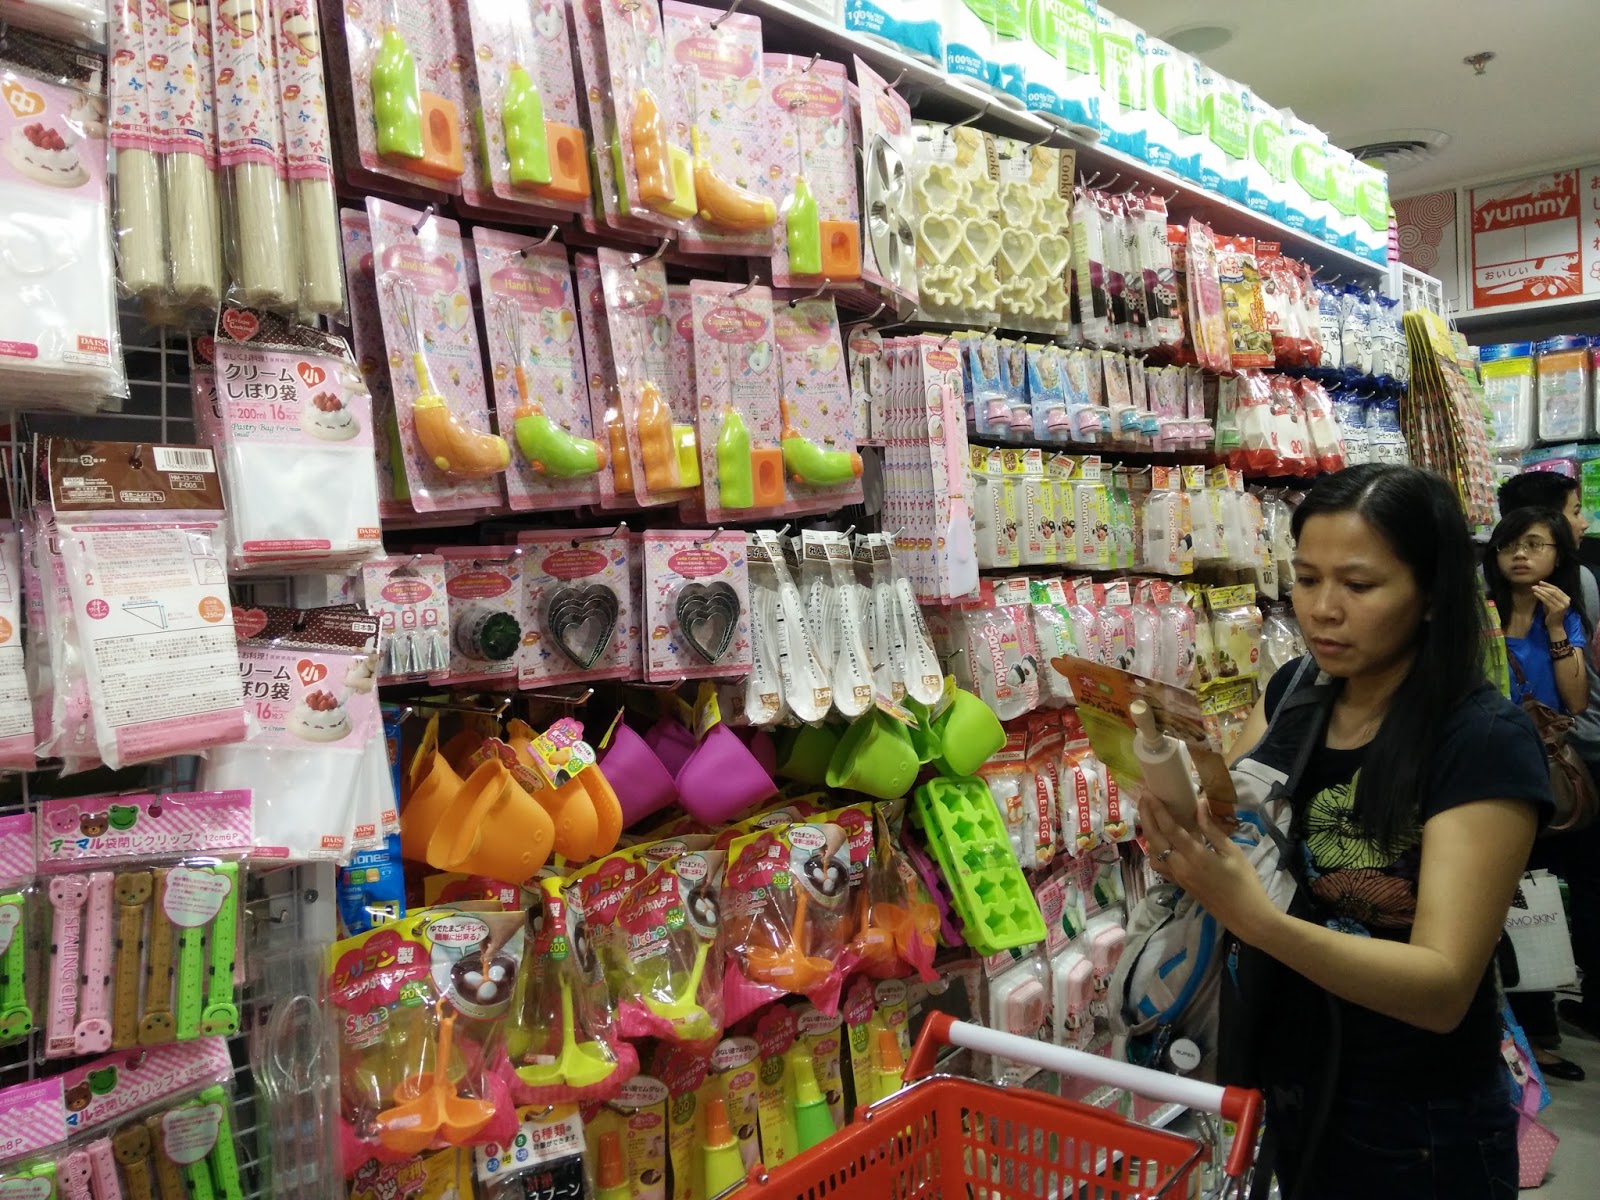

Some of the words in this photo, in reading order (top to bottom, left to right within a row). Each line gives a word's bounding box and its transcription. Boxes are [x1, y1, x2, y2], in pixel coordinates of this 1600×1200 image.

[1046, 0, 1095, 31] KITCHEN
[1053, 17, 1091, 48] TOWEL
[1482, 196, 1571, 229] yummy
[418, 263, 443, 276] Mixer
[1485, 267, 1529, 280] おいしい
[504, 279, 527, 291] Hand
[528, 281, 551, 295] Mixer
[744, 318, 762, 327] Mixer
[81, 337, 110, 349] DAISO
[225, 363, 296, 383] クリーム
[302, 369, 320, 384] 小
[226, 383, 298, 402] しぼり袋
[237, 408, 267, 420] 200ml
[231, 423, 257, 434] Pastry
[259, 424, 274, 434] Bag
[1584, 482, 1598, 492] Ice
[992, 487, 1002, 545] Manmaru
[1026, 485, 1036, 543] Manmaru
[1081, 492, 1090, 545] Manmaru
[1168, 501, 1177, 553] Korokoro
[84, 573, 95, 586] 2
[353, 623, 375, 631] 日本製
[1100, 620, 1113, 666] Sankak
[983, 624, 1006, 688] Sankaku
[239, 662, 292, 681] リーム
[301, 666, 319, 681] 小
[242, 681, 291, 701] ぼり袋
[1109, 795, 1119, 816] EGG
[1040, 815, 1050, 838] EGG
[1080, 806, 1089, 828] EGG
[49, 832, 194, 853] アニマル袋閉じクリップ
[203, 833, 239, 842] 12cm6P
[584, 886, 631, 916] エッグホルダ
[626, 877, 673, 910] シリコン製
[626, 897, 676, 923] エッグホルダー
[1505, 914, 1533, 927] SMO
[1534, 912, 1556, 924] SKIN
[429, 924, 488, 933] ゆでたまごがキレイに
[62, 917, 80, 983] SEALING
[336, 946, 415, 988] シリコン製
[61, 984, 78, 1017] CLIP
[66, 1073, 174, 1126] マル袋閉じクリップ
[532, 1123, 572, 1143] 6種類の
[529, 1183, 581, 1200] スプーン
